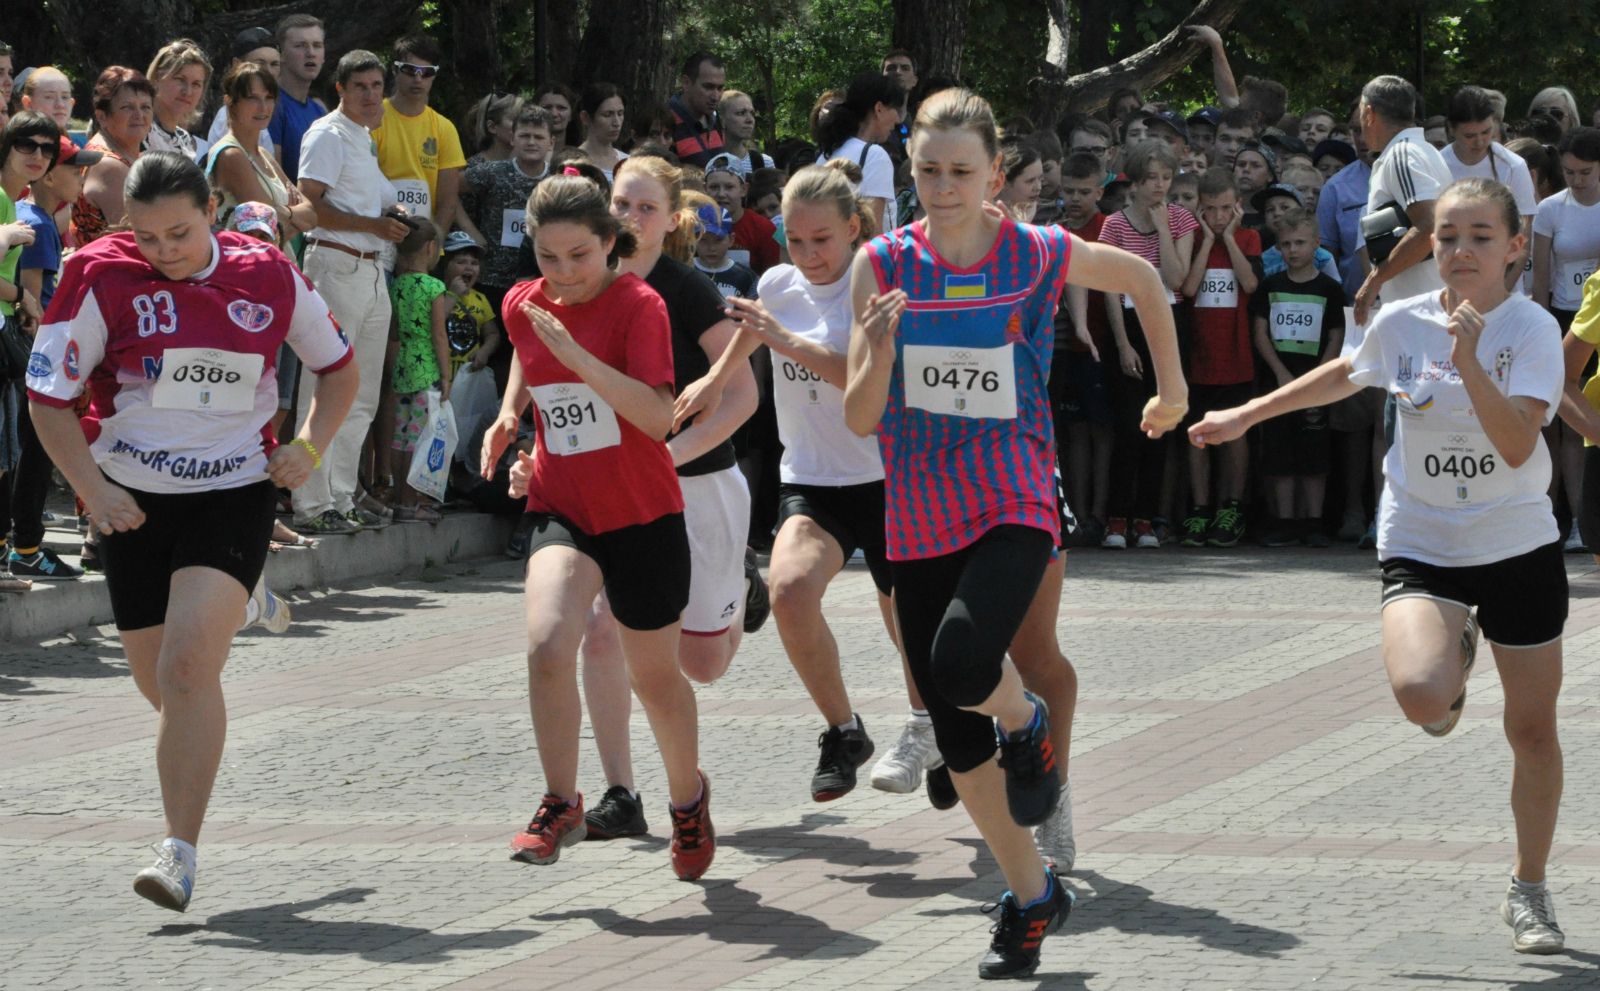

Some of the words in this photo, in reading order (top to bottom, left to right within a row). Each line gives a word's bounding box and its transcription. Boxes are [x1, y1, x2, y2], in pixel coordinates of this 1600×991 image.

[397, 190, 428, 206] 0830
[1201, 280, 1234, 294] 0824
[132, 290, 178, 338] 83
[1276, 313, 1313, 327] 0549
[172, 364, 242, 384] 0389
[922, 366, 1000, 393] 0476
[1424, 454, 1496, 479] 0406
